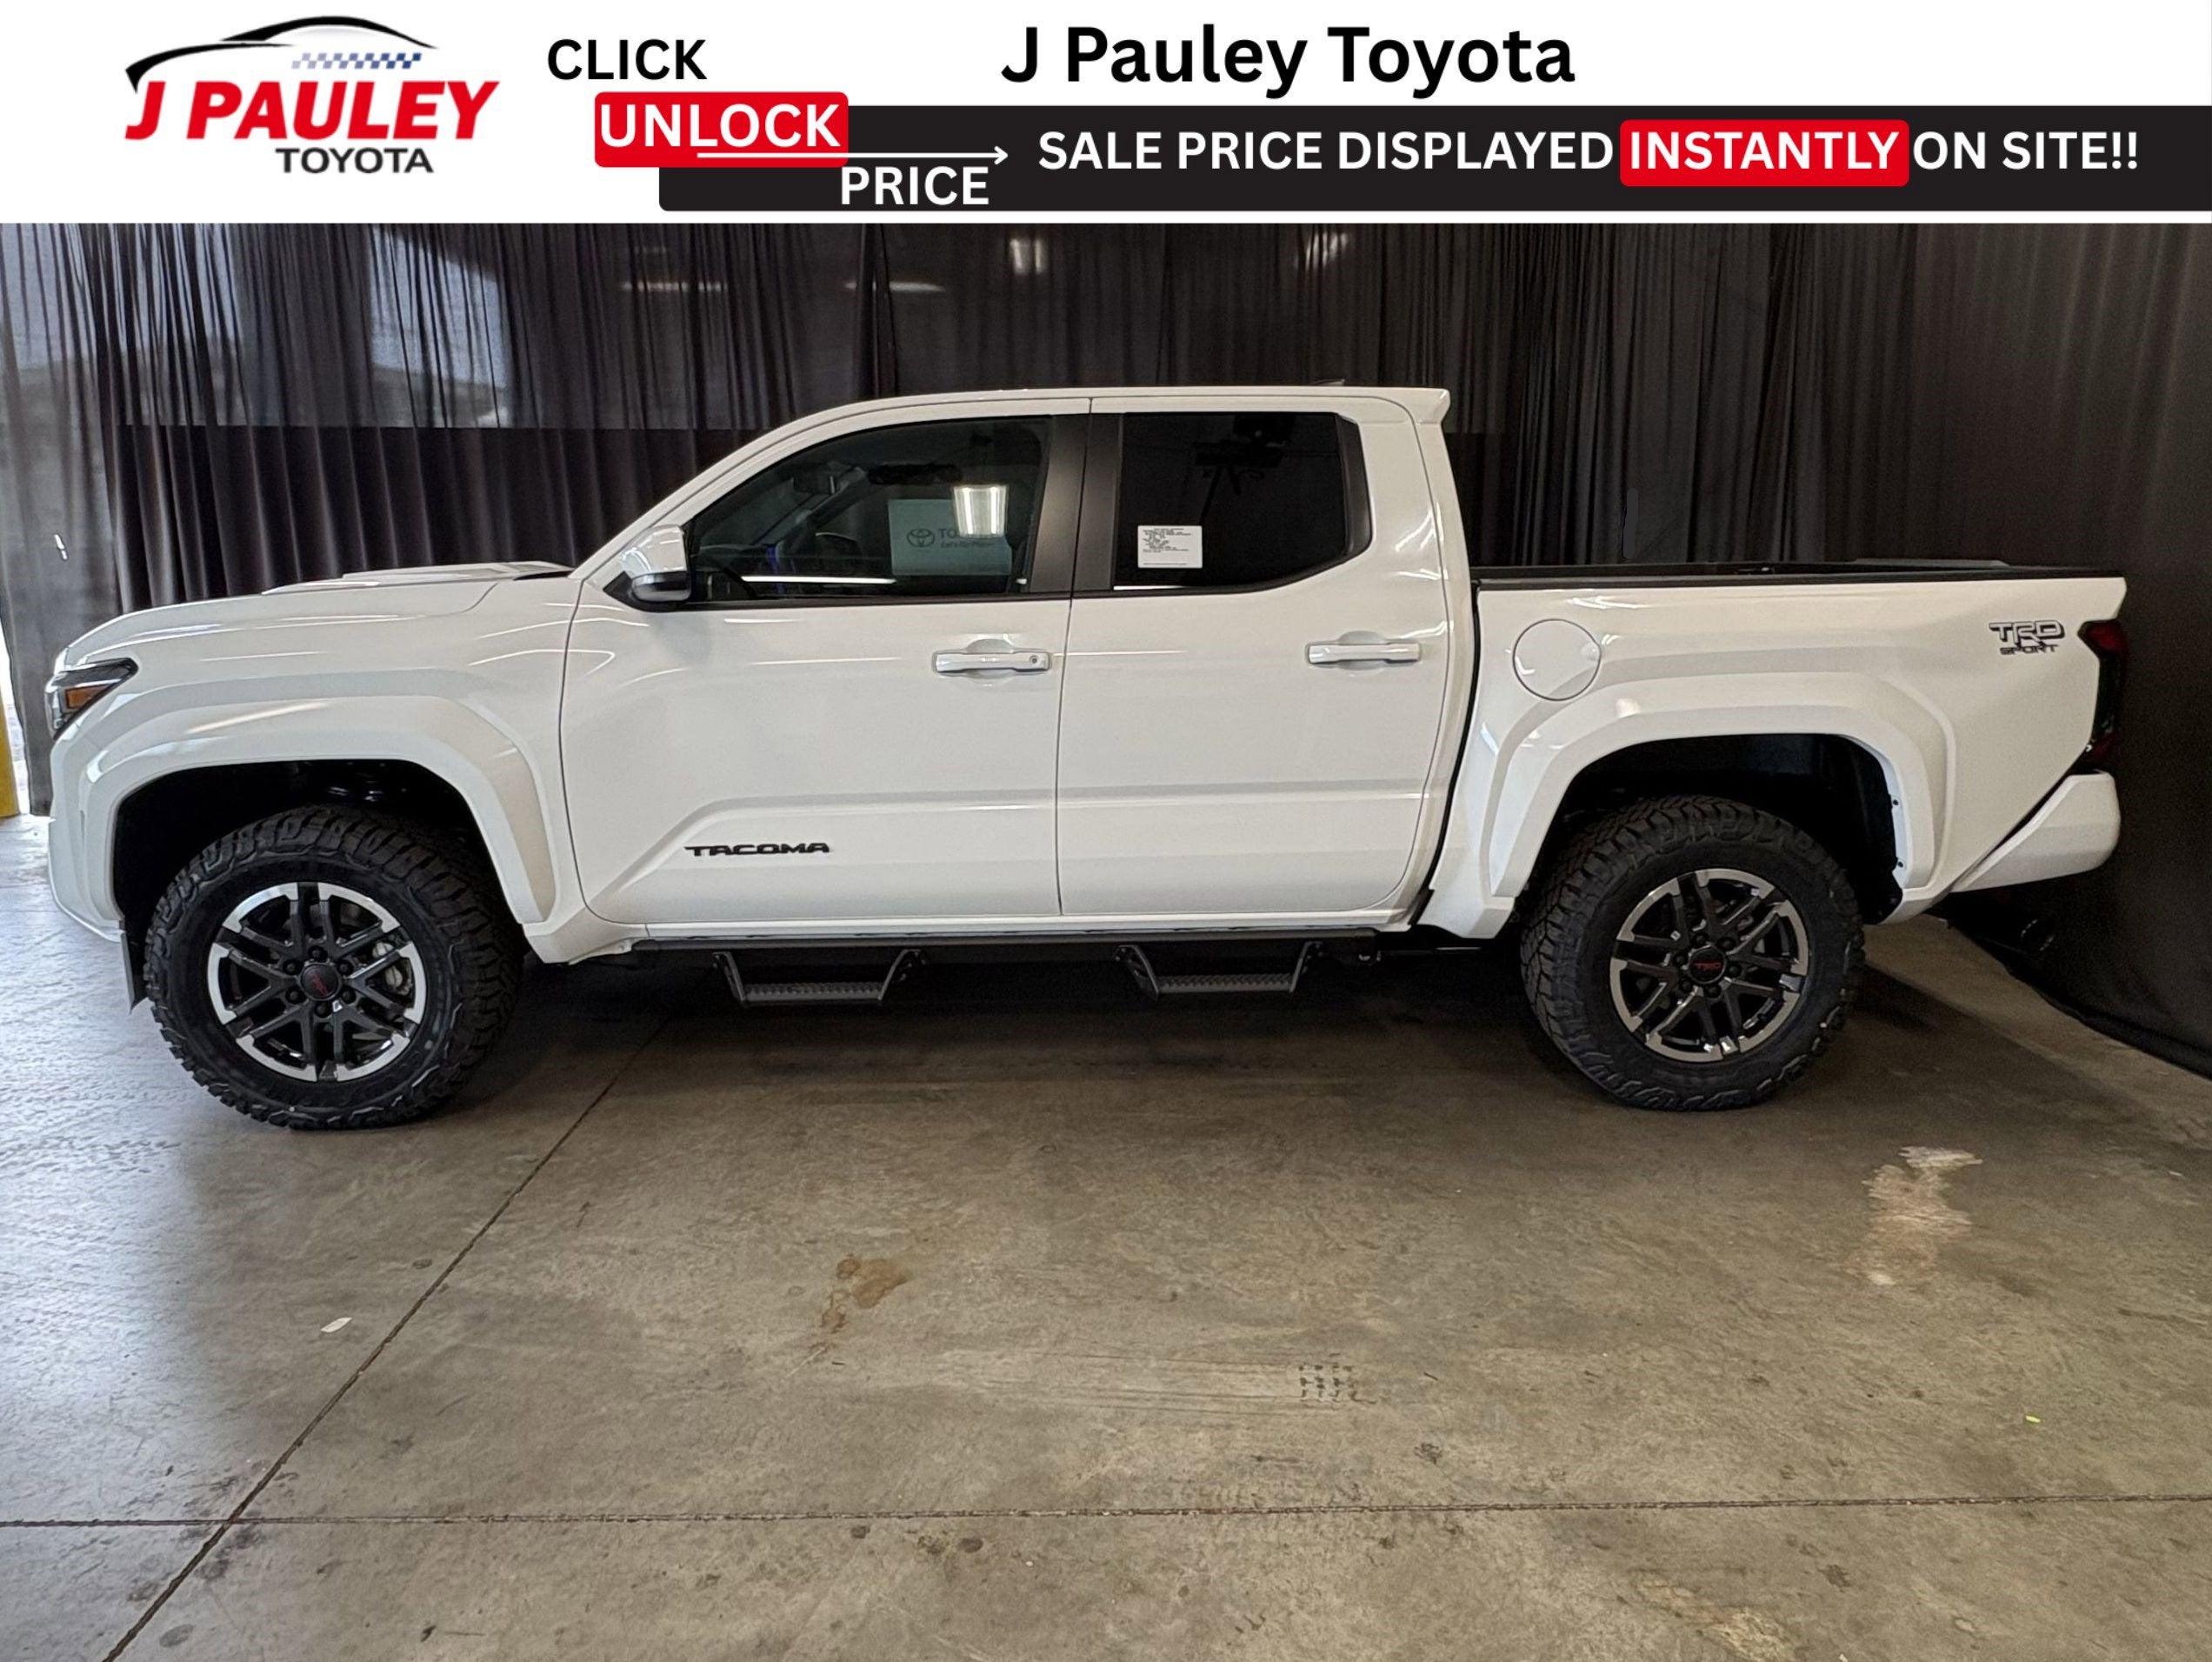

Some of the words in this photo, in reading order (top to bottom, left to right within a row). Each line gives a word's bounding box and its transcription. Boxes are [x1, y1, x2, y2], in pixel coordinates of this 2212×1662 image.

[1989, 619, 2065, 648] TRD
[2000, 644, 2058, 655] SPORT
[684, 843, 830, 857] TACOMA
